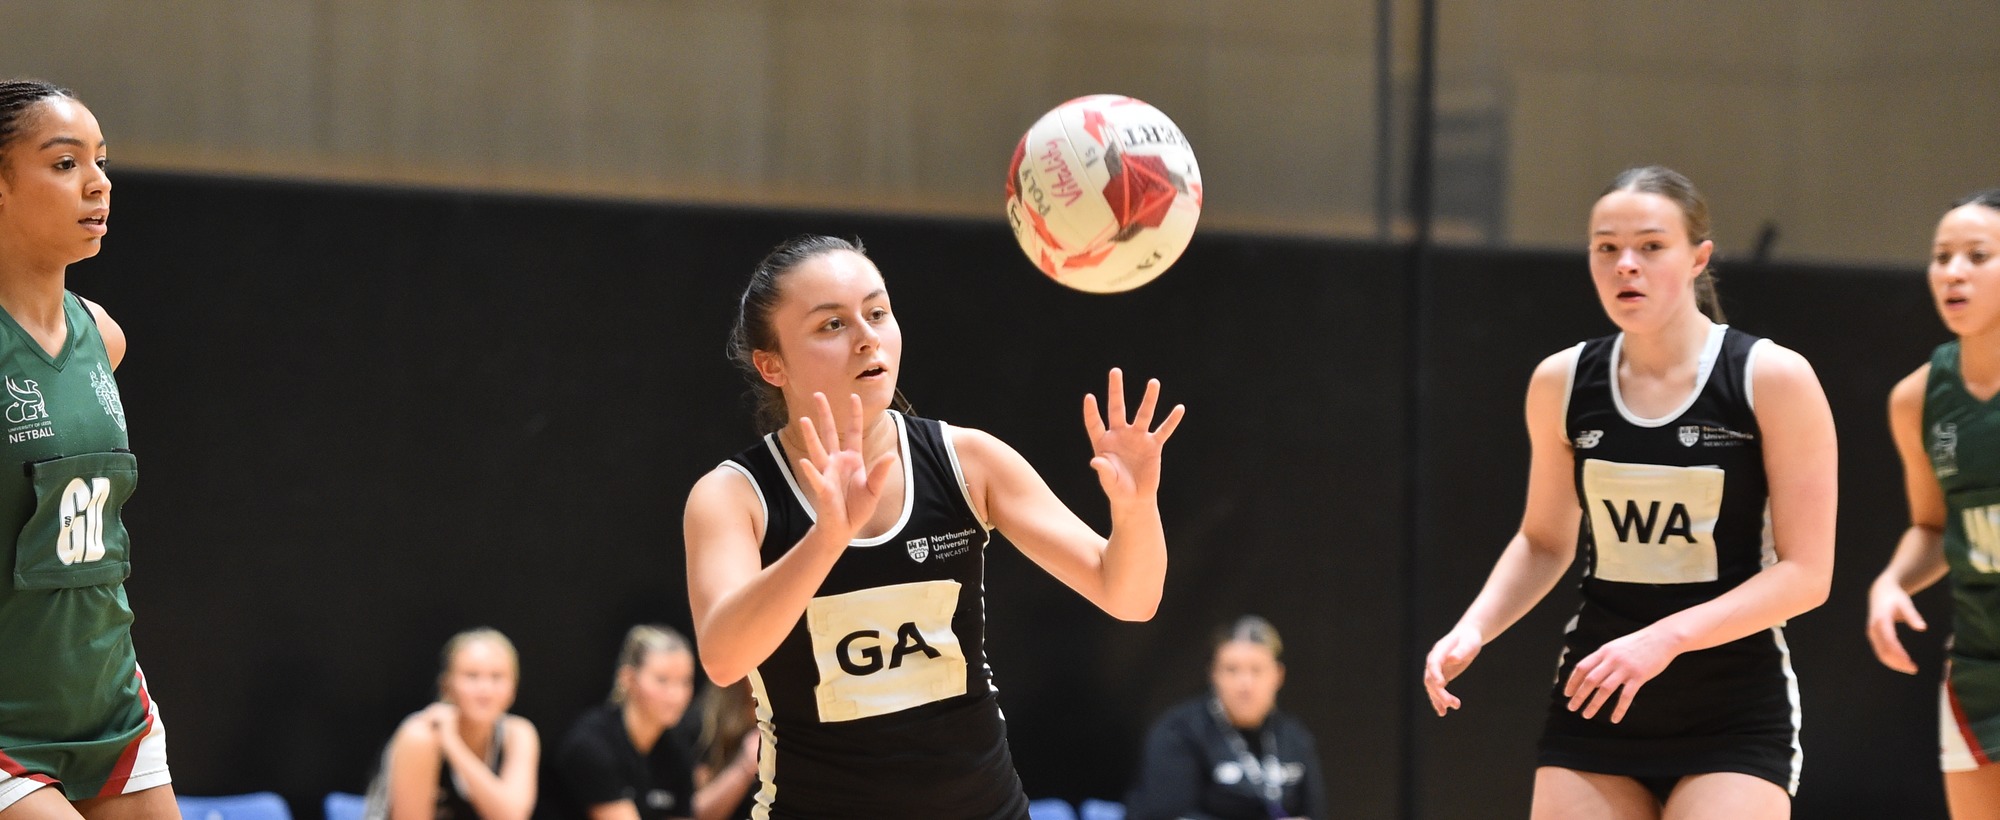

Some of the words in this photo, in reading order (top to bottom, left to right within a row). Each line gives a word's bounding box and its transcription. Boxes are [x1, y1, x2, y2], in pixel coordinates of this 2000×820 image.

[1021, 168, 1051, 217] POLY
[1040, 136, 1083, 207] Vitality
[9, 426, 55, 444] NETBALL
[56, 477, 110, 566] GD
[930, 528, 976, 544] Northumbria
[1602, 499, 1698, 544] WA
[933, 538, 969, 552] University
[935, 545, 969, 560] NEWCASTLE
[836, 622, 942, 676] GA
